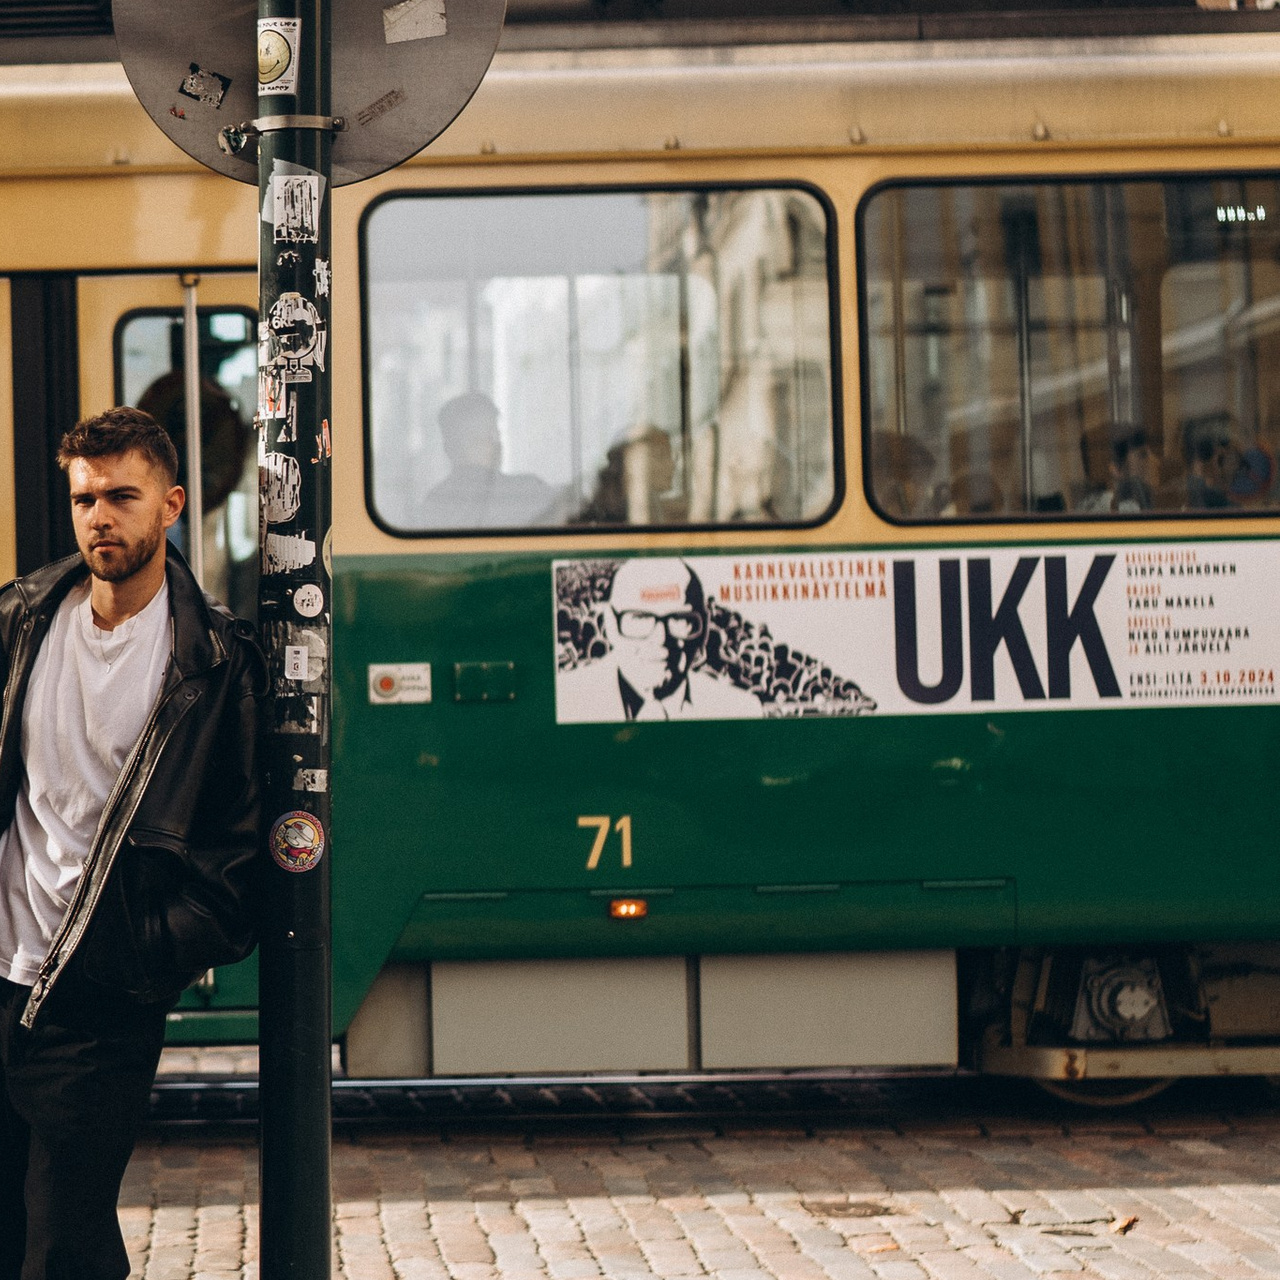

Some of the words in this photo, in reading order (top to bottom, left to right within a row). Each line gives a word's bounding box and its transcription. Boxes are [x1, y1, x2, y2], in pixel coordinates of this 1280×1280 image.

[733, 560, 886, 579] KARNEVALISTINEN
[1127, 565, 1163, 577] SIRPA
[720, 580, 887, 602] MUSIIKKINÄYTELMÄ
[1128, 598, 1158, 608] TARU
[892, 554, 1122, 705] UKK
[1128, 629, 1158, 641] NIKO
[1165, 626, 1250, 640] KUMPUVAARA
[1200, 669, 1274, 684] 3.10.2024
[577, 814, 633, 870] 71
